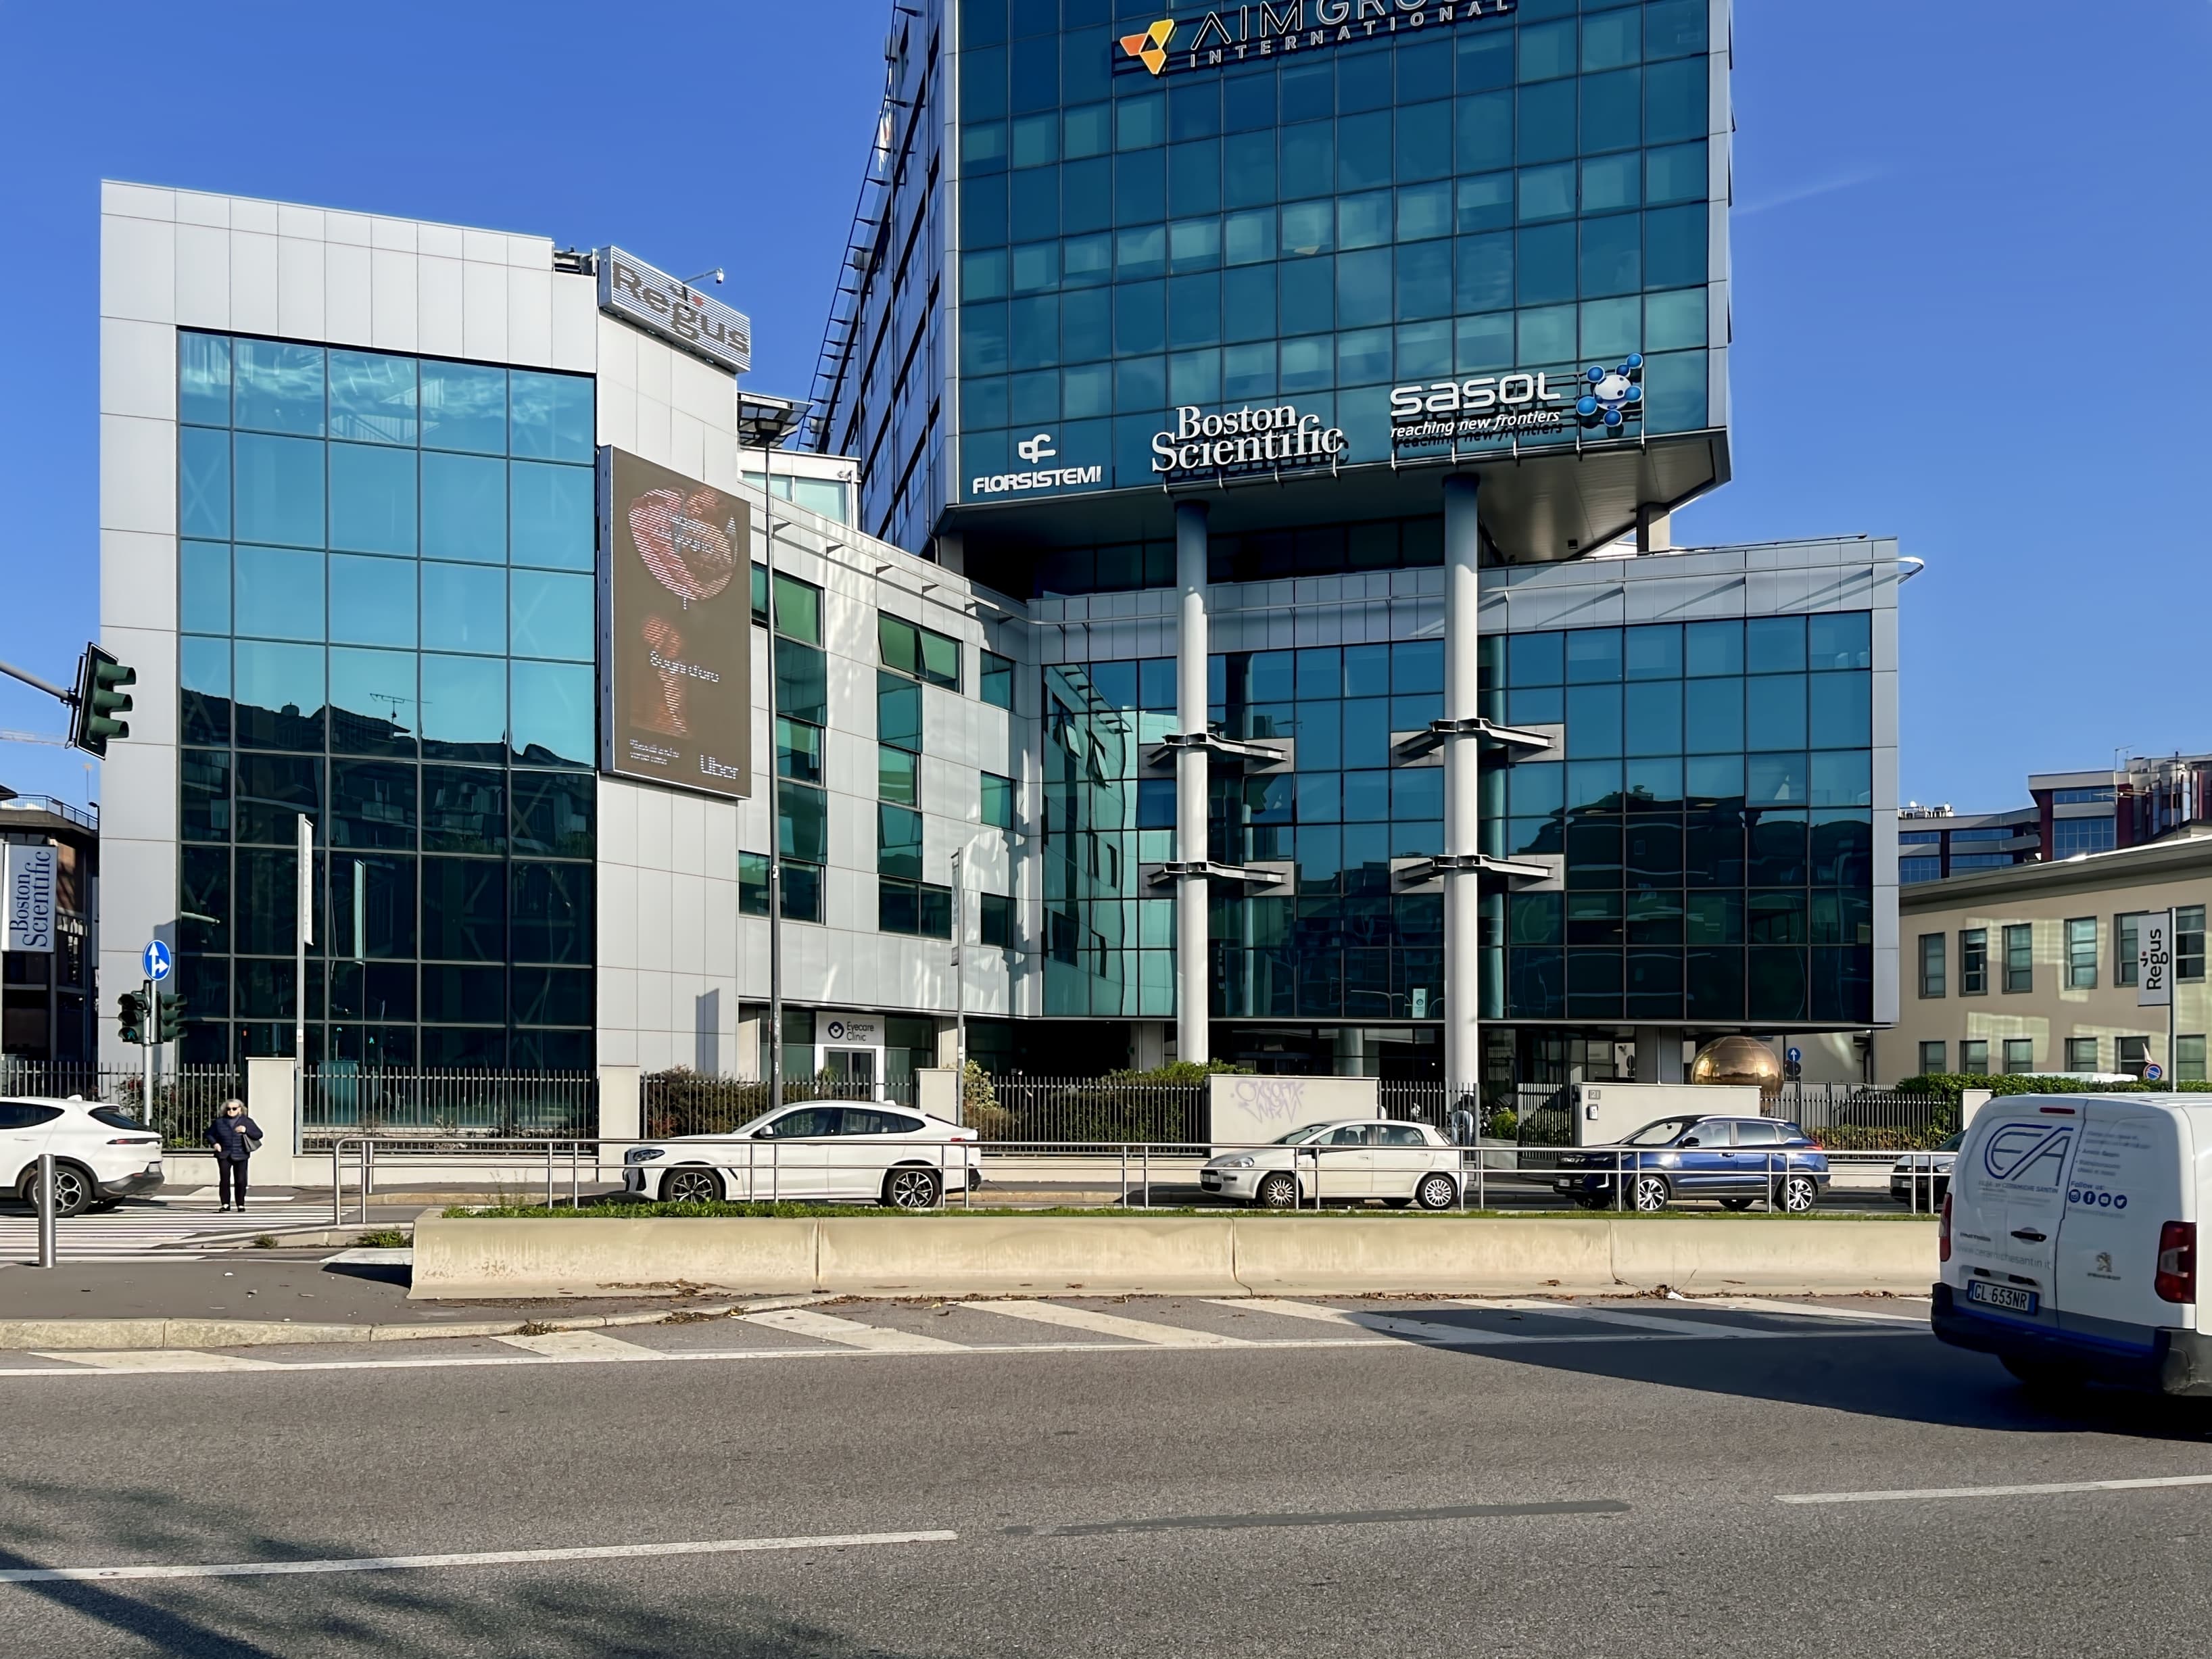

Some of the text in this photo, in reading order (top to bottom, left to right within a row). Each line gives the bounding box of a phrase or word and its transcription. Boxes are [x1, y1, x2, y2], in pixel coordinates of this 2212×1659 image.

[1190, 0, 1508, 67] INTERNATIONAL
[1191, 1, 1302, 51] AIM
[613, 262, 749, 354] Regus
[1151, 414, 1343, 472] Scientific
[1176, 405, 1297, 440] Boston
[1390, 410, 1561, 438] reaching new frontiers
[700, 754, 738, 779] Uber
[9, 873, 30, 932] Boston
[22, 851, 51, 947] Scientific
[2146, 929, 2169, 990] Regus
[846, 1021, 874, 1032] Eyecare
[846, 1032, 866, 1042] Clinic
[2070, 1180, 2093, 1188] Follow
